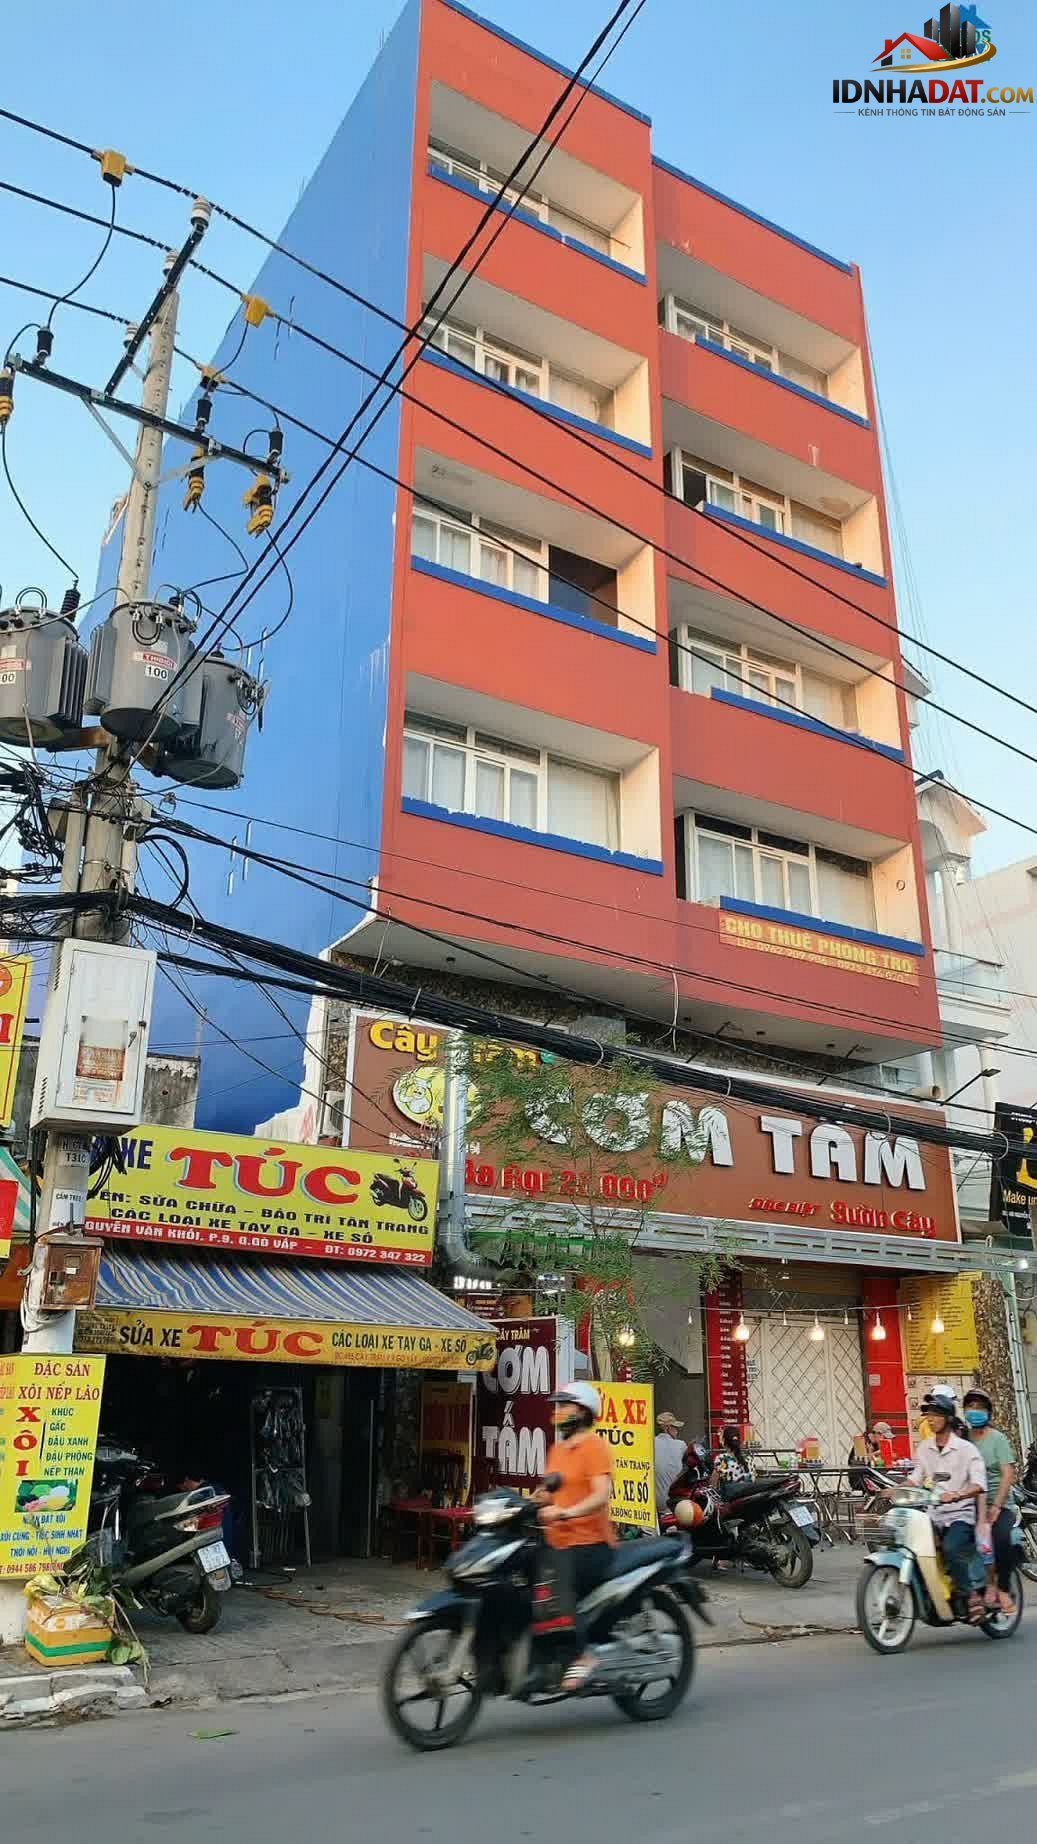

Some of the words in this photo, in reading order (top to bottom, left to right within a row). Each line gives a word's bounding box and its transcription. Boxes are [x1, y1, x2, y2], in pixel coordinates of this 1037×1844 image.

[147, 665, 168, 679] 100
[725, 917, 763, 939] CHO
[768, 926, 812, 950] THUÊ
[369, 1020, 439, 1062] Cây
[121, 1137, 153, 1170] XE
[167, 1147, 361, 1205] TÚC
[1003, 1190, 1026, 1206] Make
[209, 1219, 231, 1229] XE
[238, 1221, 271, 1233] TAY
[277, 1225, 300, 1237] GA
[324, 1230, 344, 1241] XE
[376, 1221, 429, 1235] TRANG
[85, 1219, 130, 1234] GUYỄN
[348, 1247, 377, 1258] 0972
[380, 1250, 400, 1261] 347
[404, 1253, 426, 1264] 322
[120, 1319, 153, 1346] SỬA
[160, 1327, 183, 1348] XE
[187, 1321, 324, 1357] TÚC
[332, 1329, 352, 1347] CÁC
[355, 1332, 378, 1352] LOẠI
[382, 1335, 394, 1350] XE
[397, 1336, 416, 1352] TAY
[419, 1337, 432, 1351] GA
[441, 1338, 452, 1352] XE
[454, 1335, 467, 1352] SỐ
[18, 1384, 41, 1399] XÔI
[46, 1380, 72, 1400] NẾP
[623, 1398, 647, 1425] XE
[67, 1437, 89, 1446] XANH
[482, 1400, 547, 1477] TẤM
[596, 1425, 634, 1446] TÚC
[623, 1480, 635, 1502] XE
